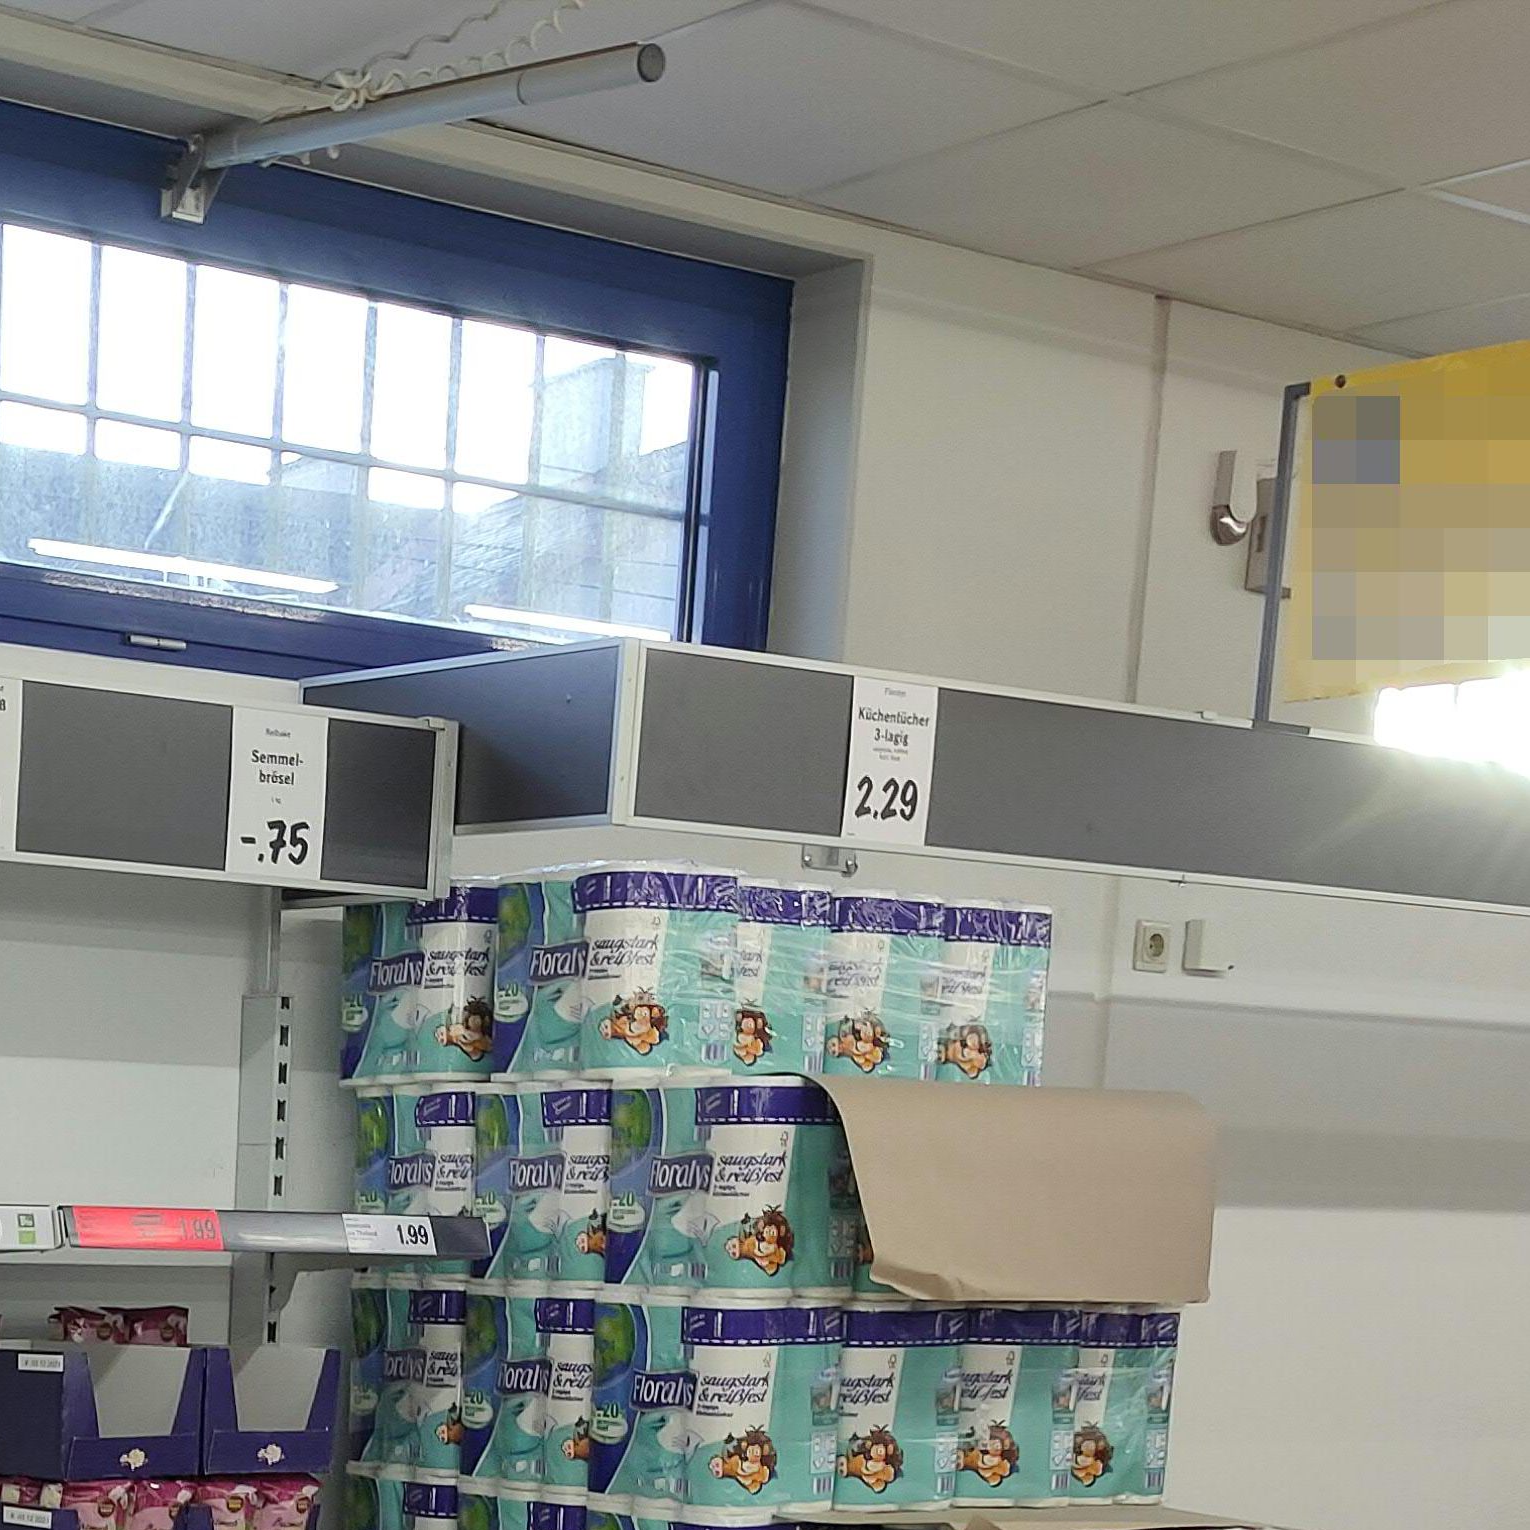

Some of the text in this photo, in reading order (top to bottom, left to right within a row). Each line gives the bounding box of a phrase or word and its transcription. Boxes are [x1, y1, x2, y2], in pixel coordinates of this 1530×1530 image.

[859, 706, 929, 727] Küchentücher
[874, 728, 909, 746] 3-lagig
[251, 749, 303, 766] Semmel-
[259, 770, 294, 785] brösel
[855, 775, 918, 821] 2.29
[240, 820, 310, 865] -.75
[592, 938, 658, 957] saugstark
[371, 957, 422, 987] Floralys
[717, 1152, 787, 1169] saugstark
[651, 1160, 712, 1189] Floralys
[397, 1224, 428, 1245] 1.99
[633, 1375, 695, 1405] Floralys
[701, 1372, 769, 1392] saugstark
